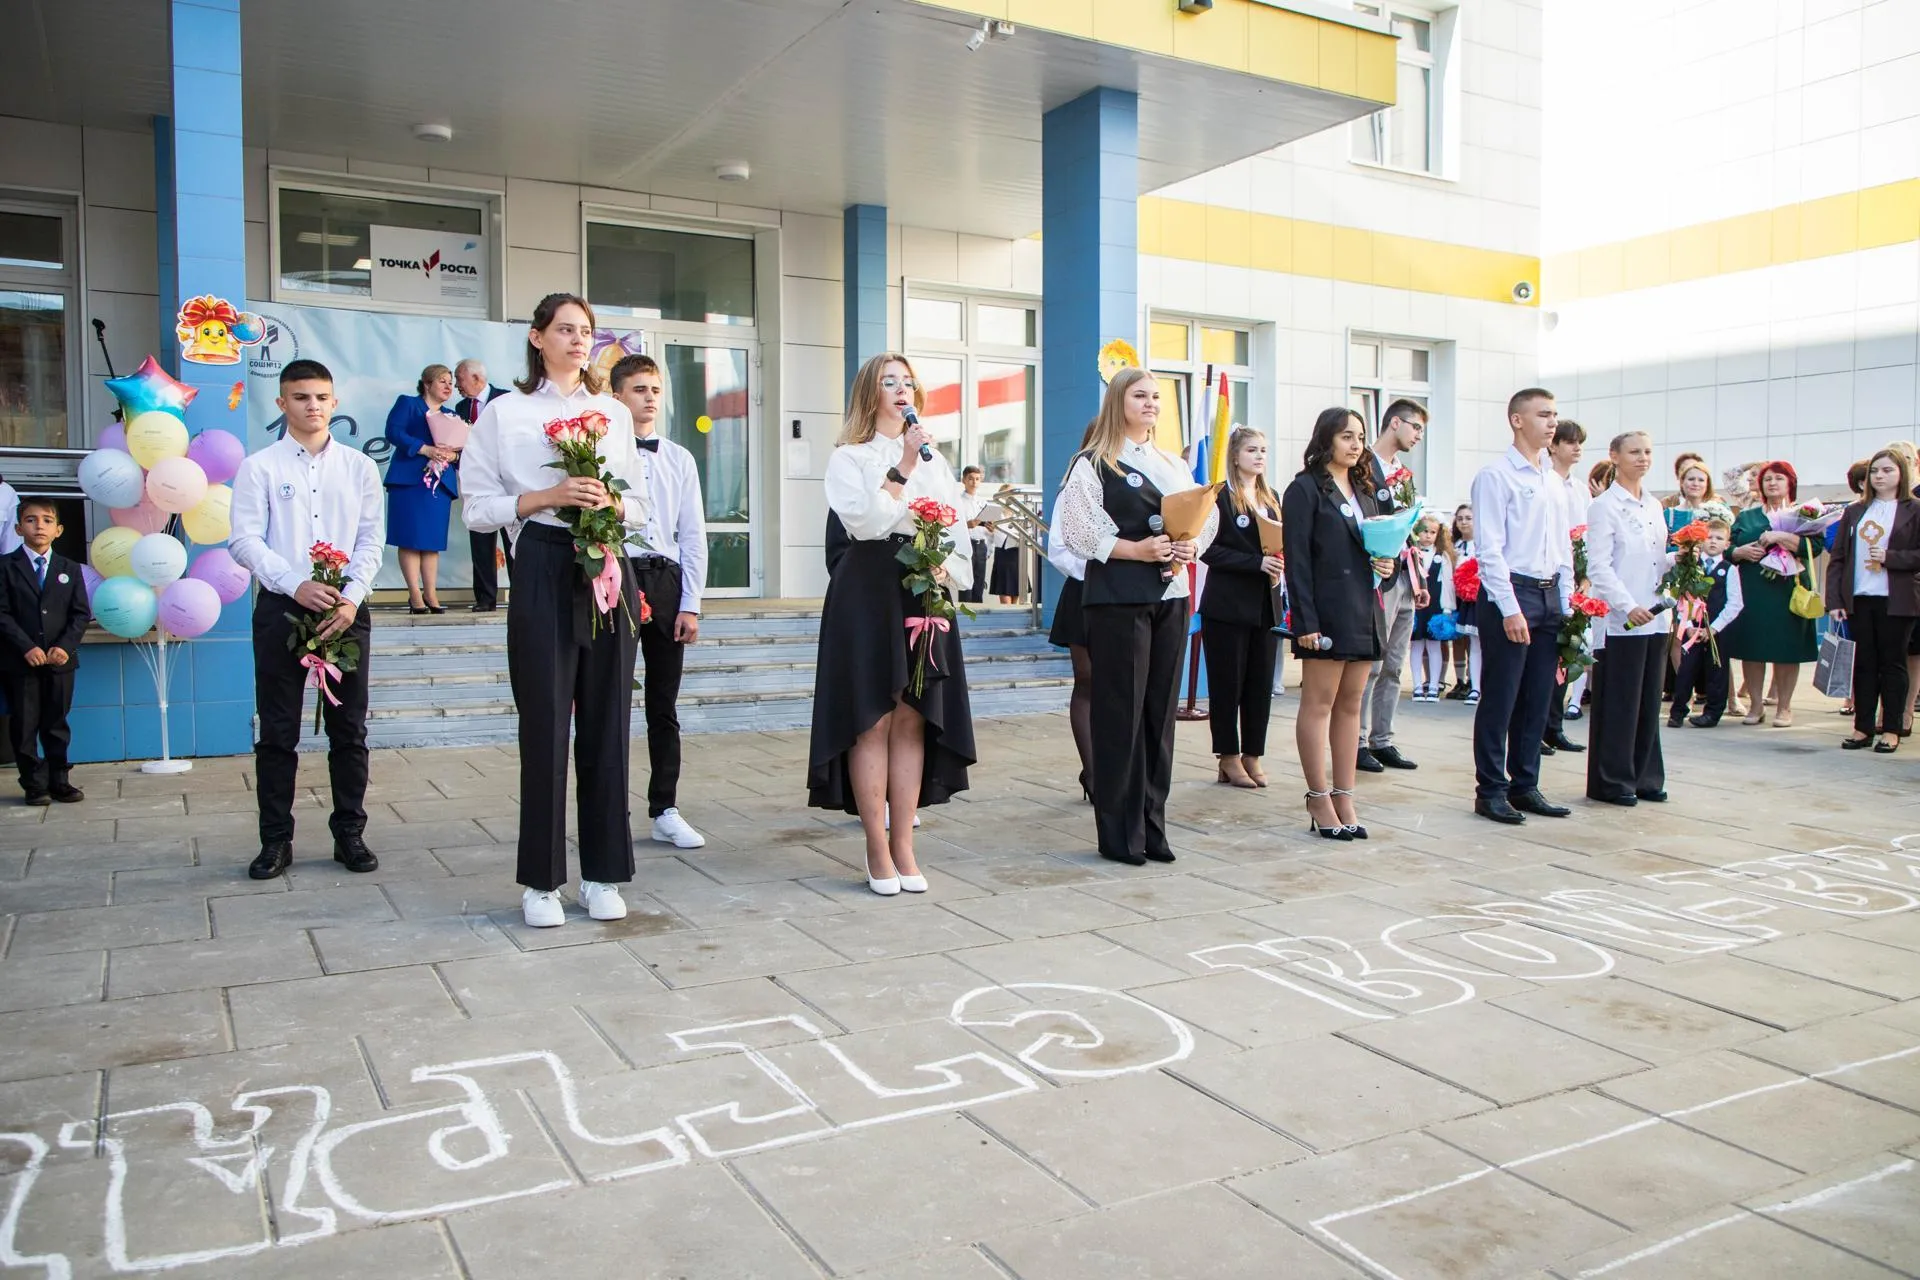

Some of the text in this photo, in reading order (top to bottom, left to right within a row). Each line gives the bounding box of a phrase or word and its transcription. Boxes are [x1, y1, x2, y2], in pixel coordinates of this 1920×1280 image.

[379, 258, 477, 274] ТОЧКА РОСТА
[0, 982, 1195, 1280] СТРА
